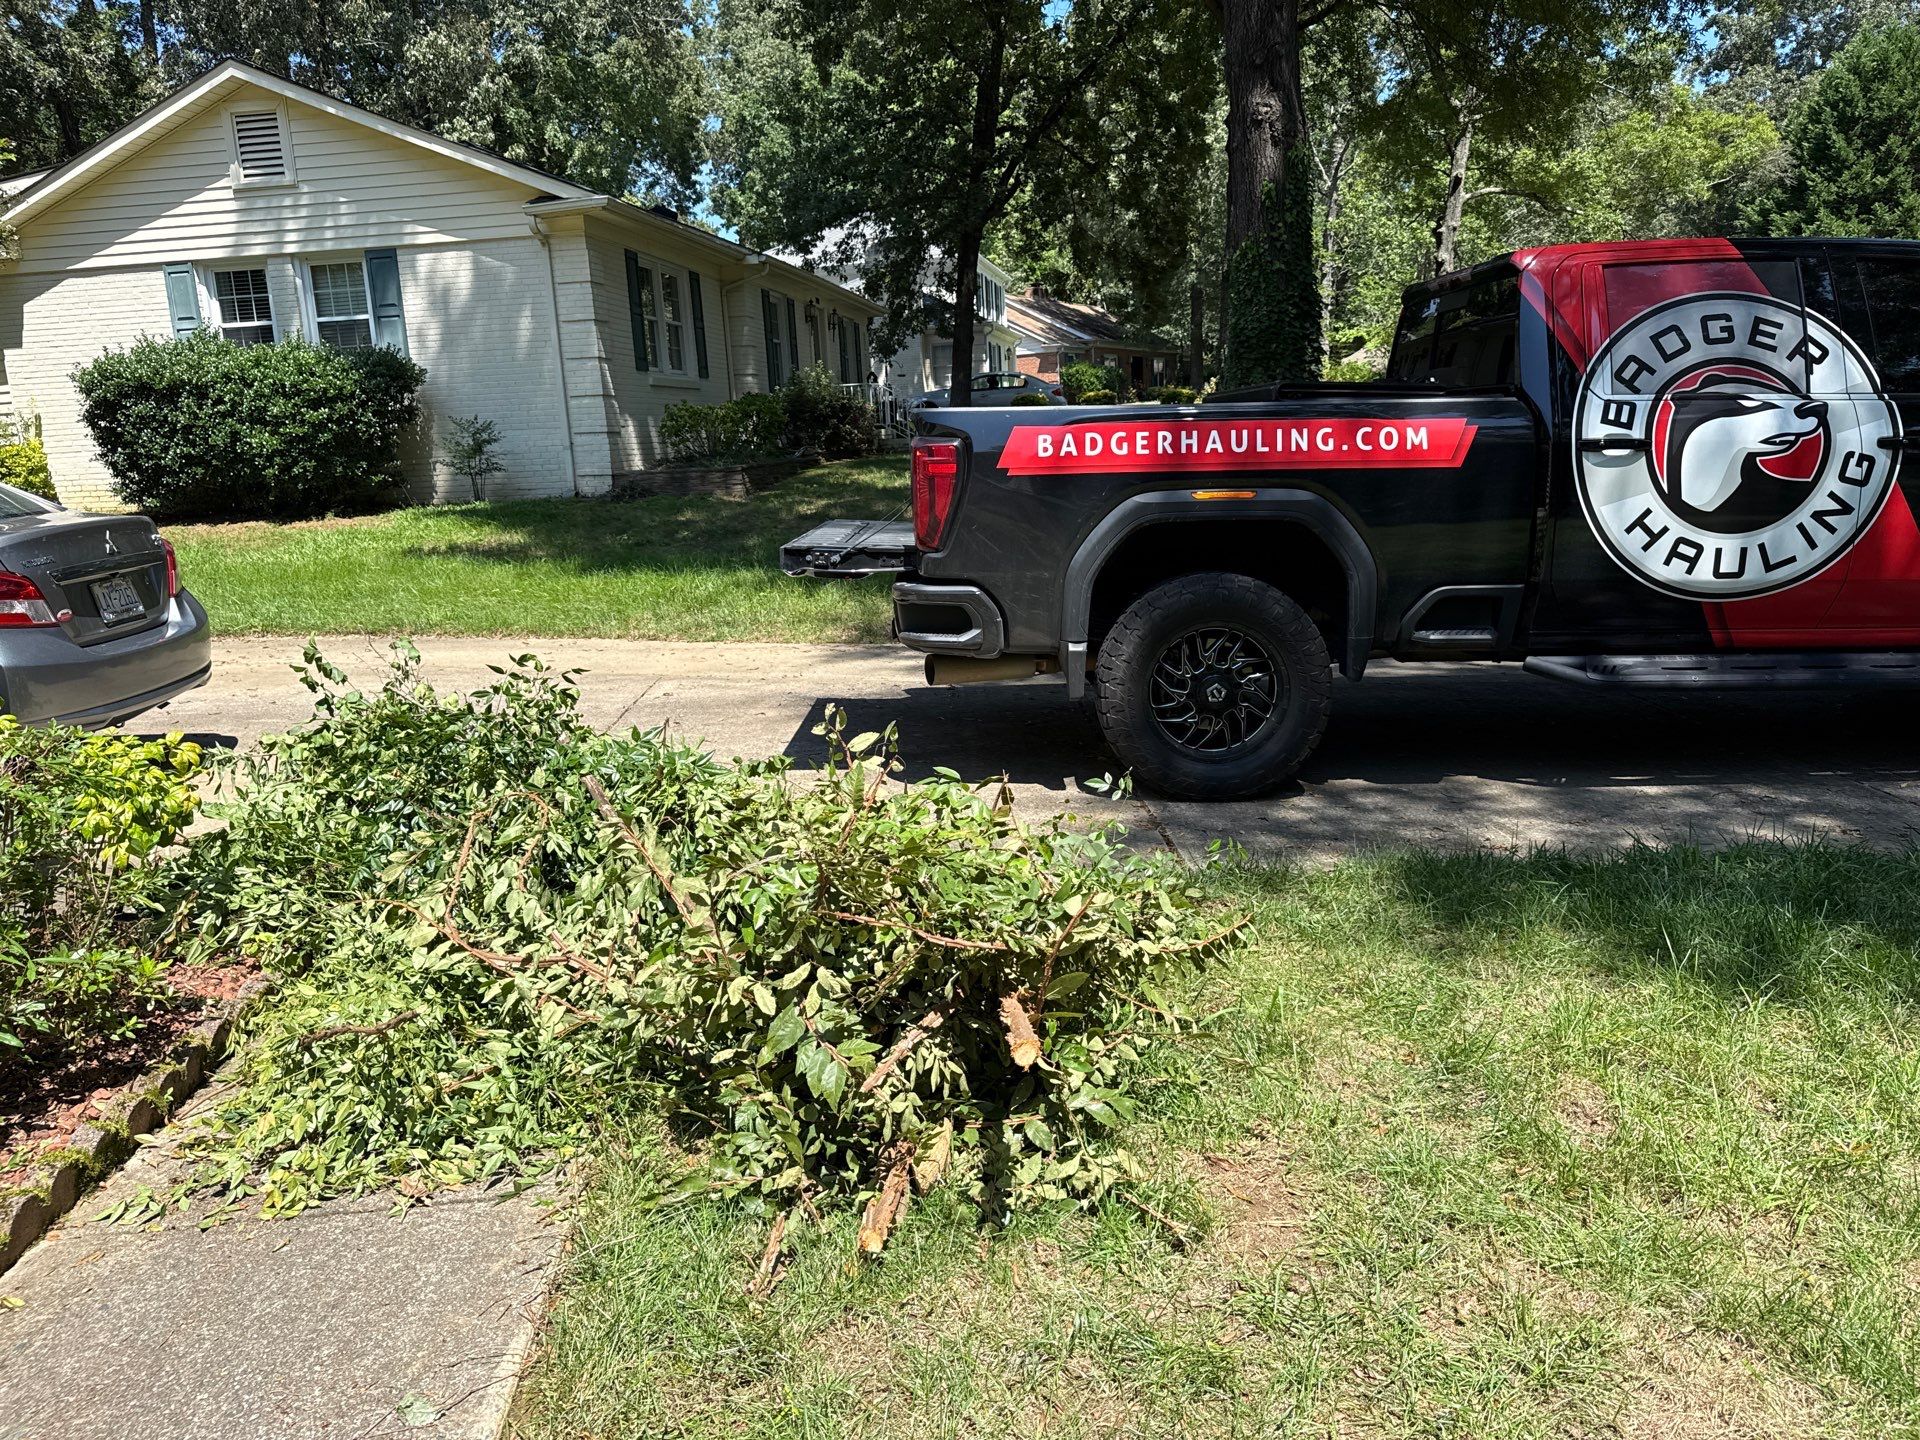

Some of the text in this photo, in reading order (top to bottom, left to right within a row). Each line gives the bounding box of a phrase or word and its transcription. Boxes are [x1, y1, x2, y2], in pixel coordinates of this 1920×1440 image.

[1599, 312, 1830, 430] BADGER
[1036, 425, 1430, 458] BADGERHAULING.COM
[1623, 449, 1876, 580] HAULING
